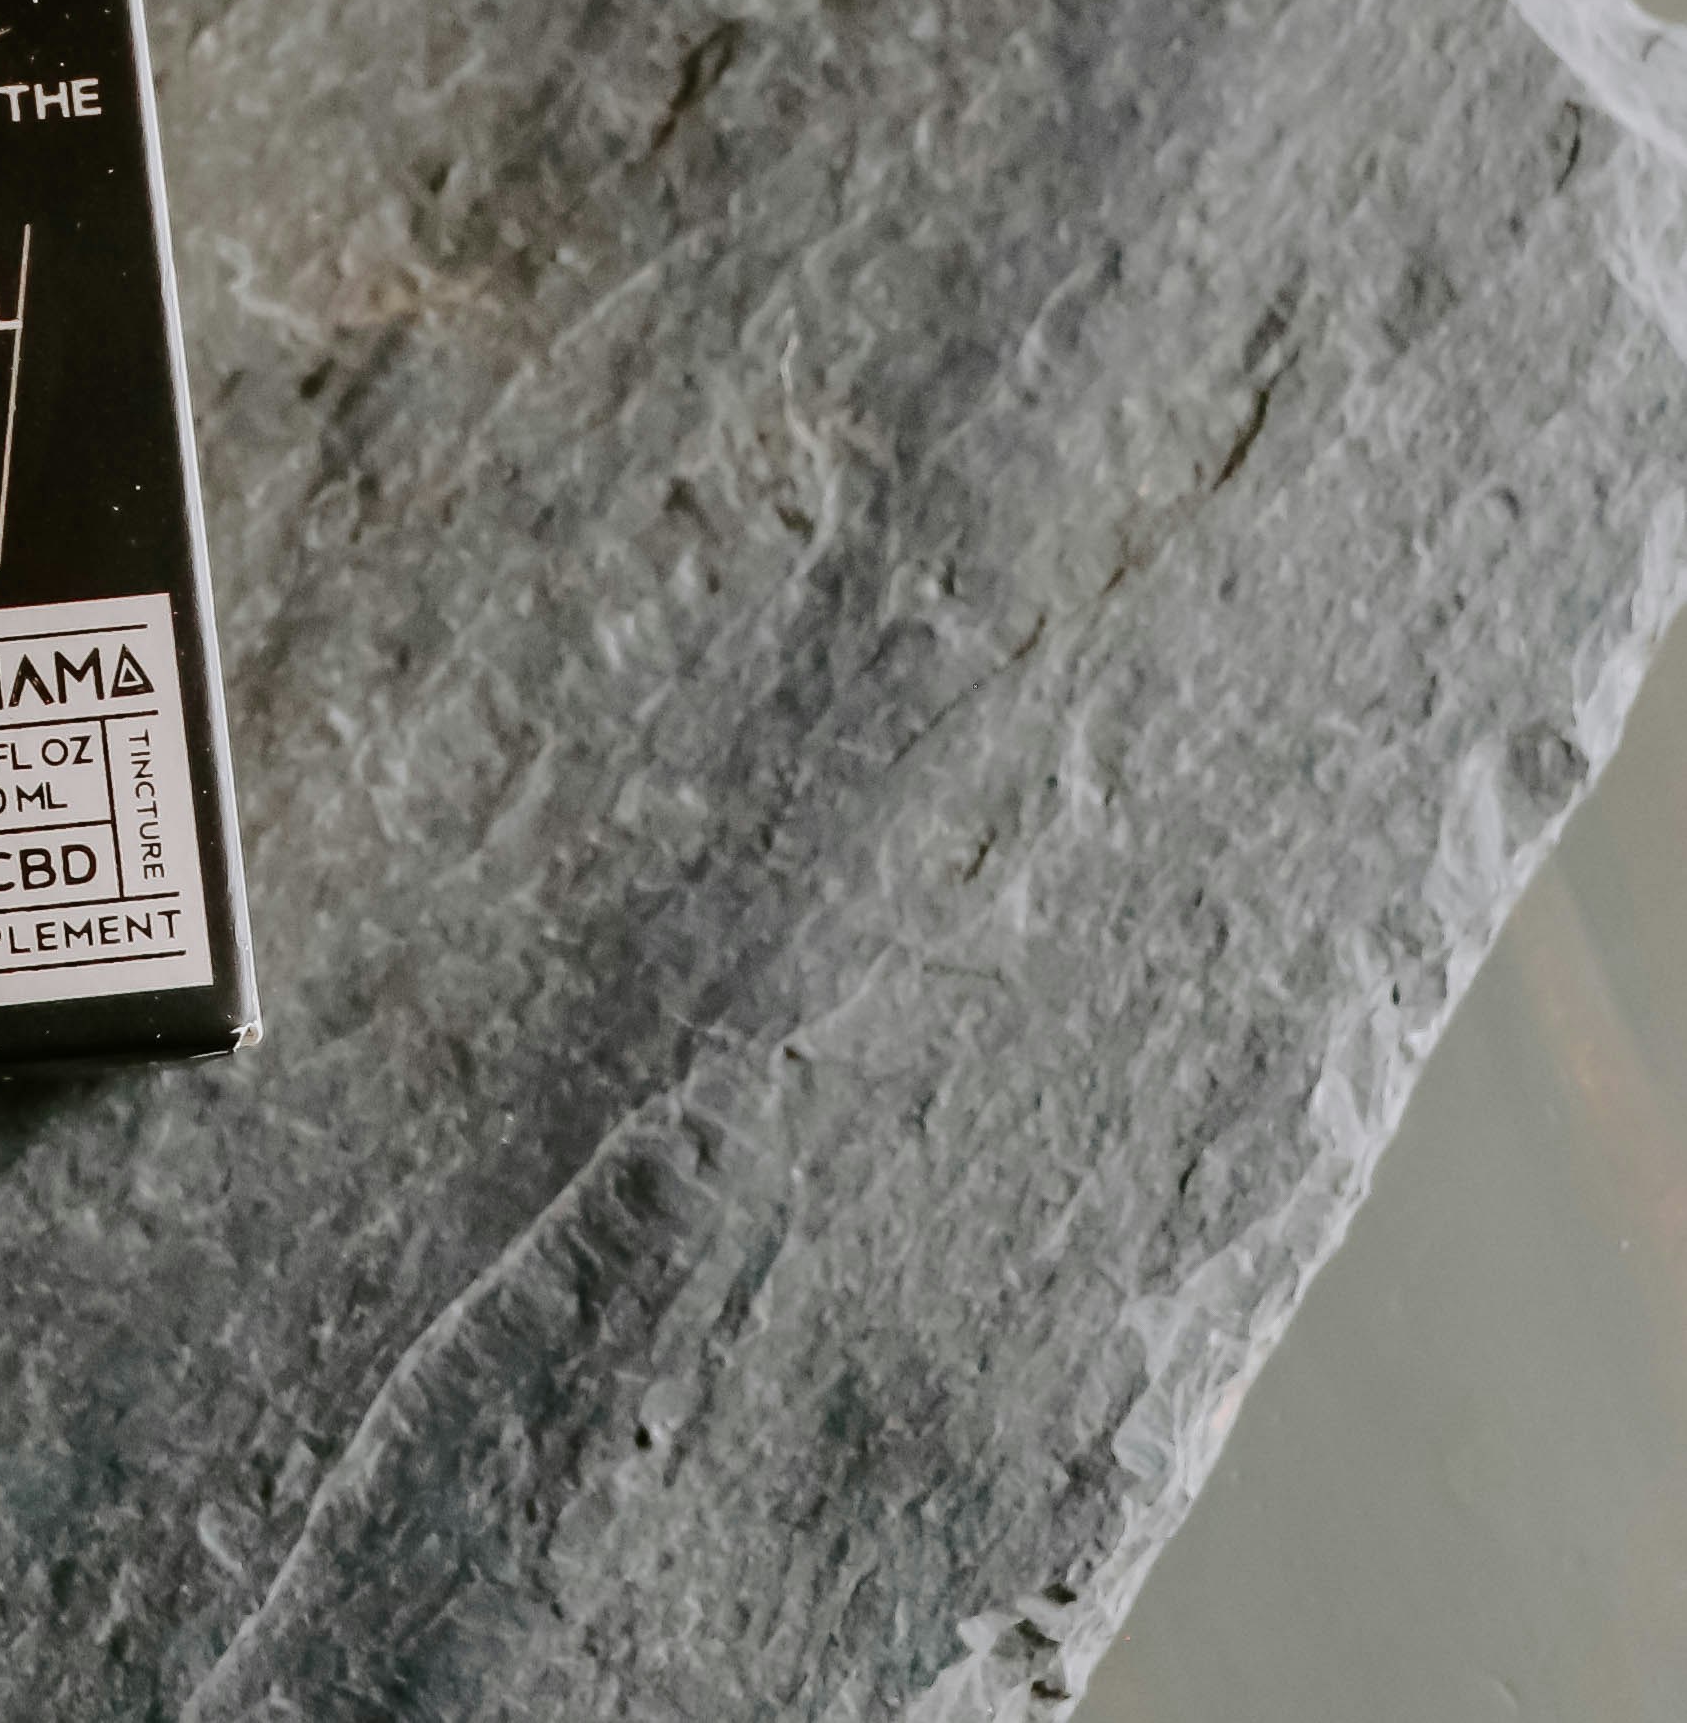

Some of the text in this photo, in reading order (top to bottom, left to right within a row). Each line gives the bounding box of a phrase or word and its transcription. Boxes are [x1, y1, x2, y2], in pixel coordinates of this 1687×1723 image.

[41, 735, 95, 767] OZ
[16, 779, 69, 810] ML
[126, 728, 166, 881] TINCTURE
